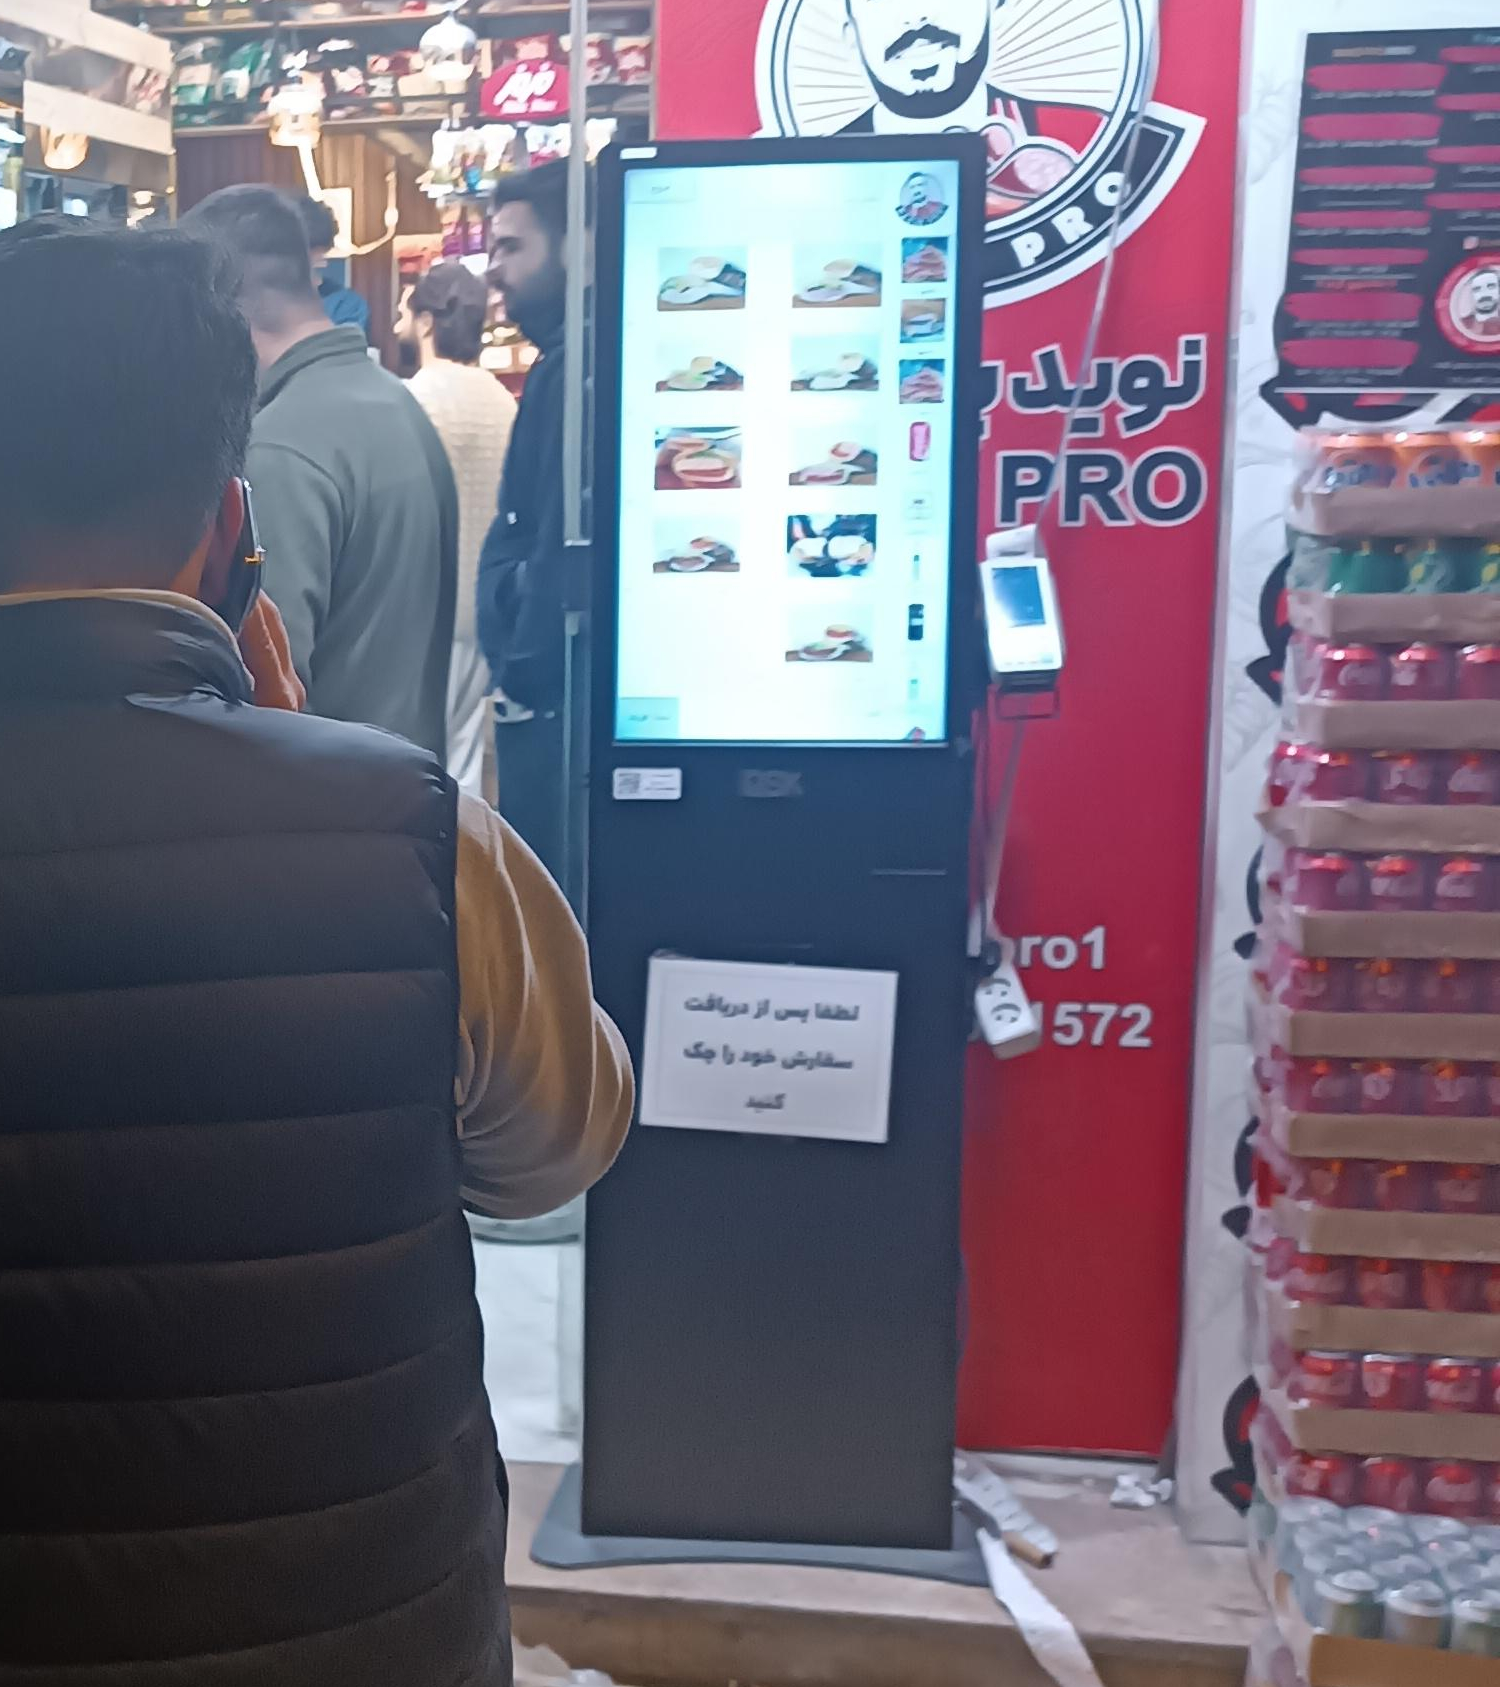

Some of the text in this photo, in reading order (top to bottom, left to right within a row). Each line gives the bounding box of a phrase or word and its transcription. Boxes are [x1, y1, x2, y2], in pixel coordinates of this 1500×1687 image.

[1010, 171, 1132, 269] PRO
[995, 446, 1208, 528] PRO
[1019, 925, 1106, 970] ro1
[684, 994, 860, 1023] لطفا پس از دریافت
[683, 1041, 853, 1070] سفارش خود را چک
[746, 1093, 786, 1113] کنید
